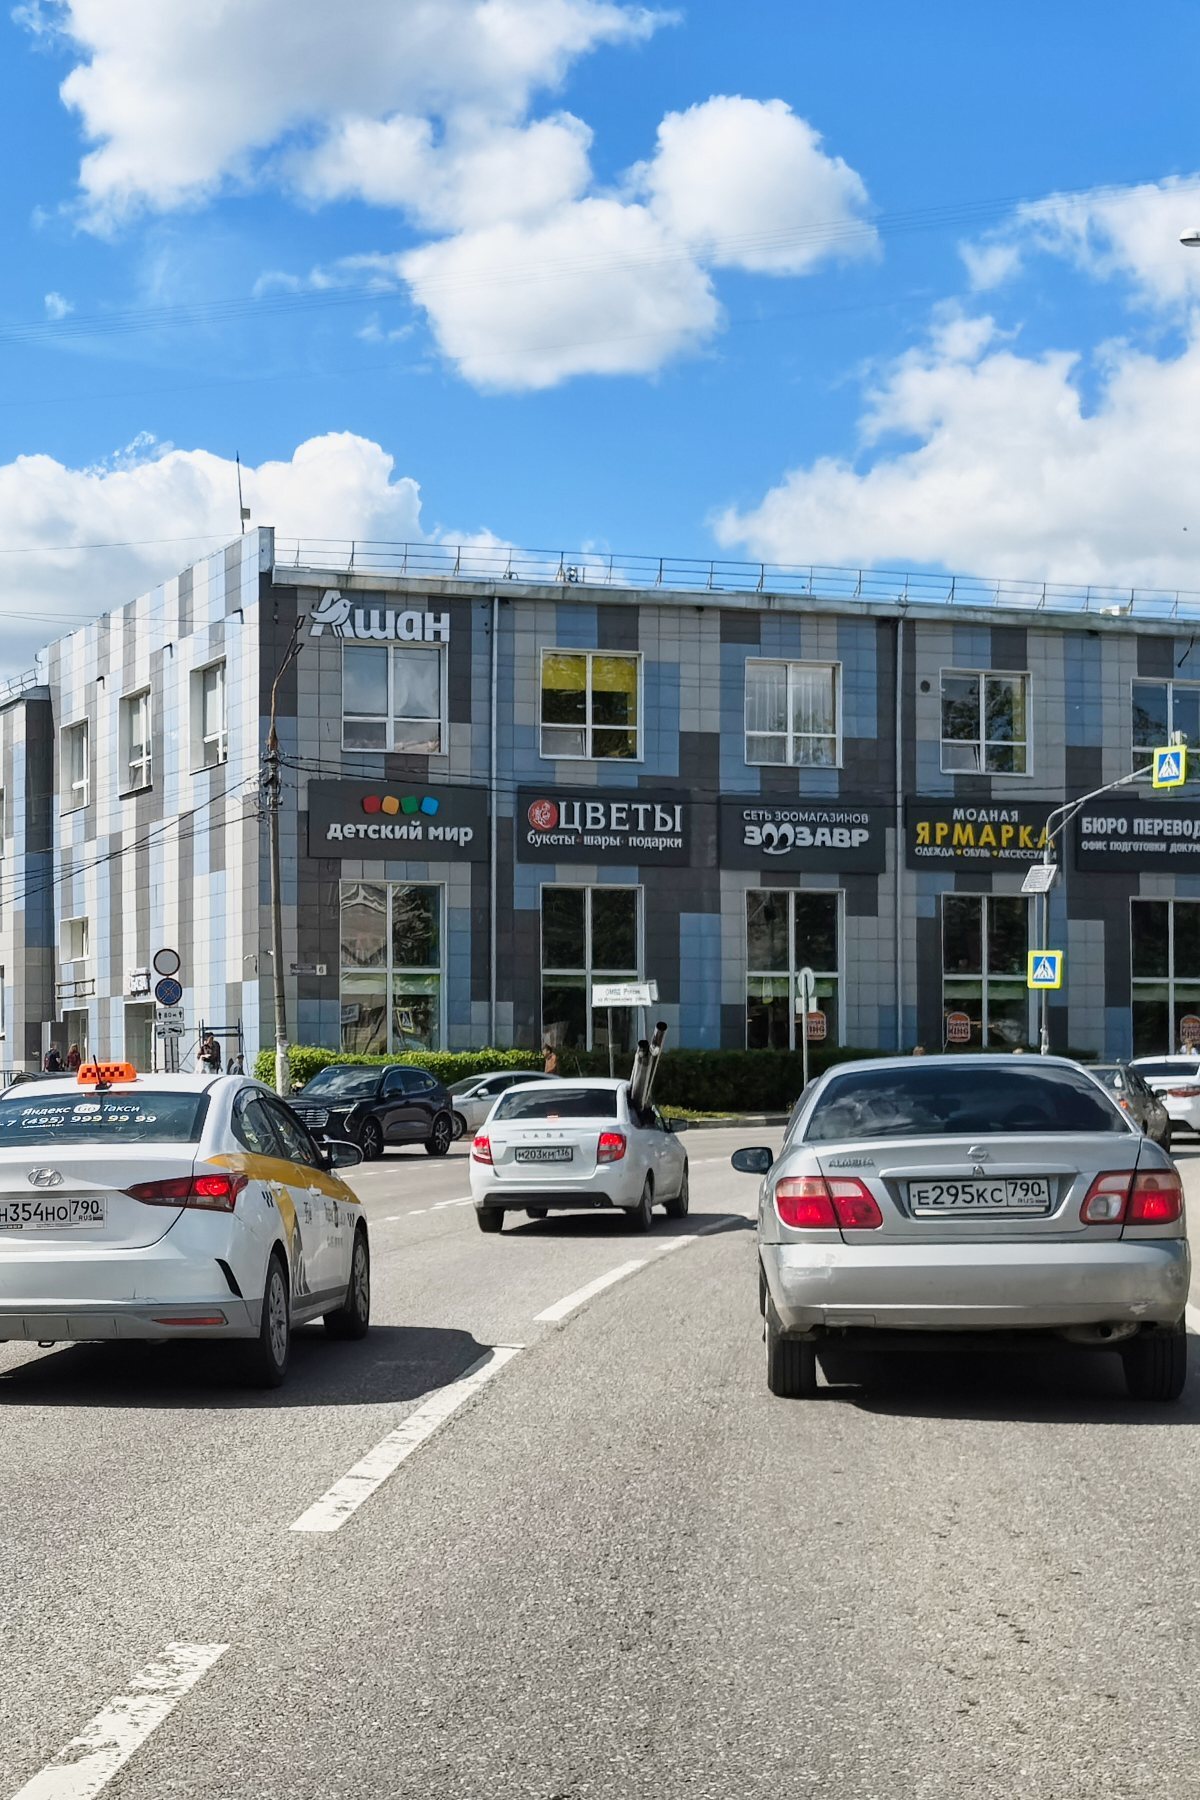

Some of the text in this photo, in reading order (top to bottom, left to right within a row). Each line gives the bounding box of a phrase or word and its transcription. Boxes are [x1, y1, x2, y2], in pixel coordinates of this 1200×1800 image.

[558, 801, 683, 834] ЦВЕТЫ
[743, 809, 869, 824] СЕТЬ ЗООМАГАЗИНОВ
[952, 807, 1019, 823] МОДНАЯ
[326, 820, 474, 847] детский мир
[915, 821, 1056, 849] ЯРМАРКА
[1081, 817, 1128, 835] БЮРО
[527, 829, 683, 851] букеты шары подарки
[743, 822, 870, 855] ЗООЗАВР
[914, 846, 955, 857] ОДЕЖДА
[21, 1106, 71, 1116] Яндекс
[103, 1104, 140, 1112] Такси
[21, 1116, 65, 1126] (495)
[70, 1115, 103, 1123] 999
[917, 1181, 1042, 1206] Е295КС 790
[71, 1200, 99, 1215] 790
